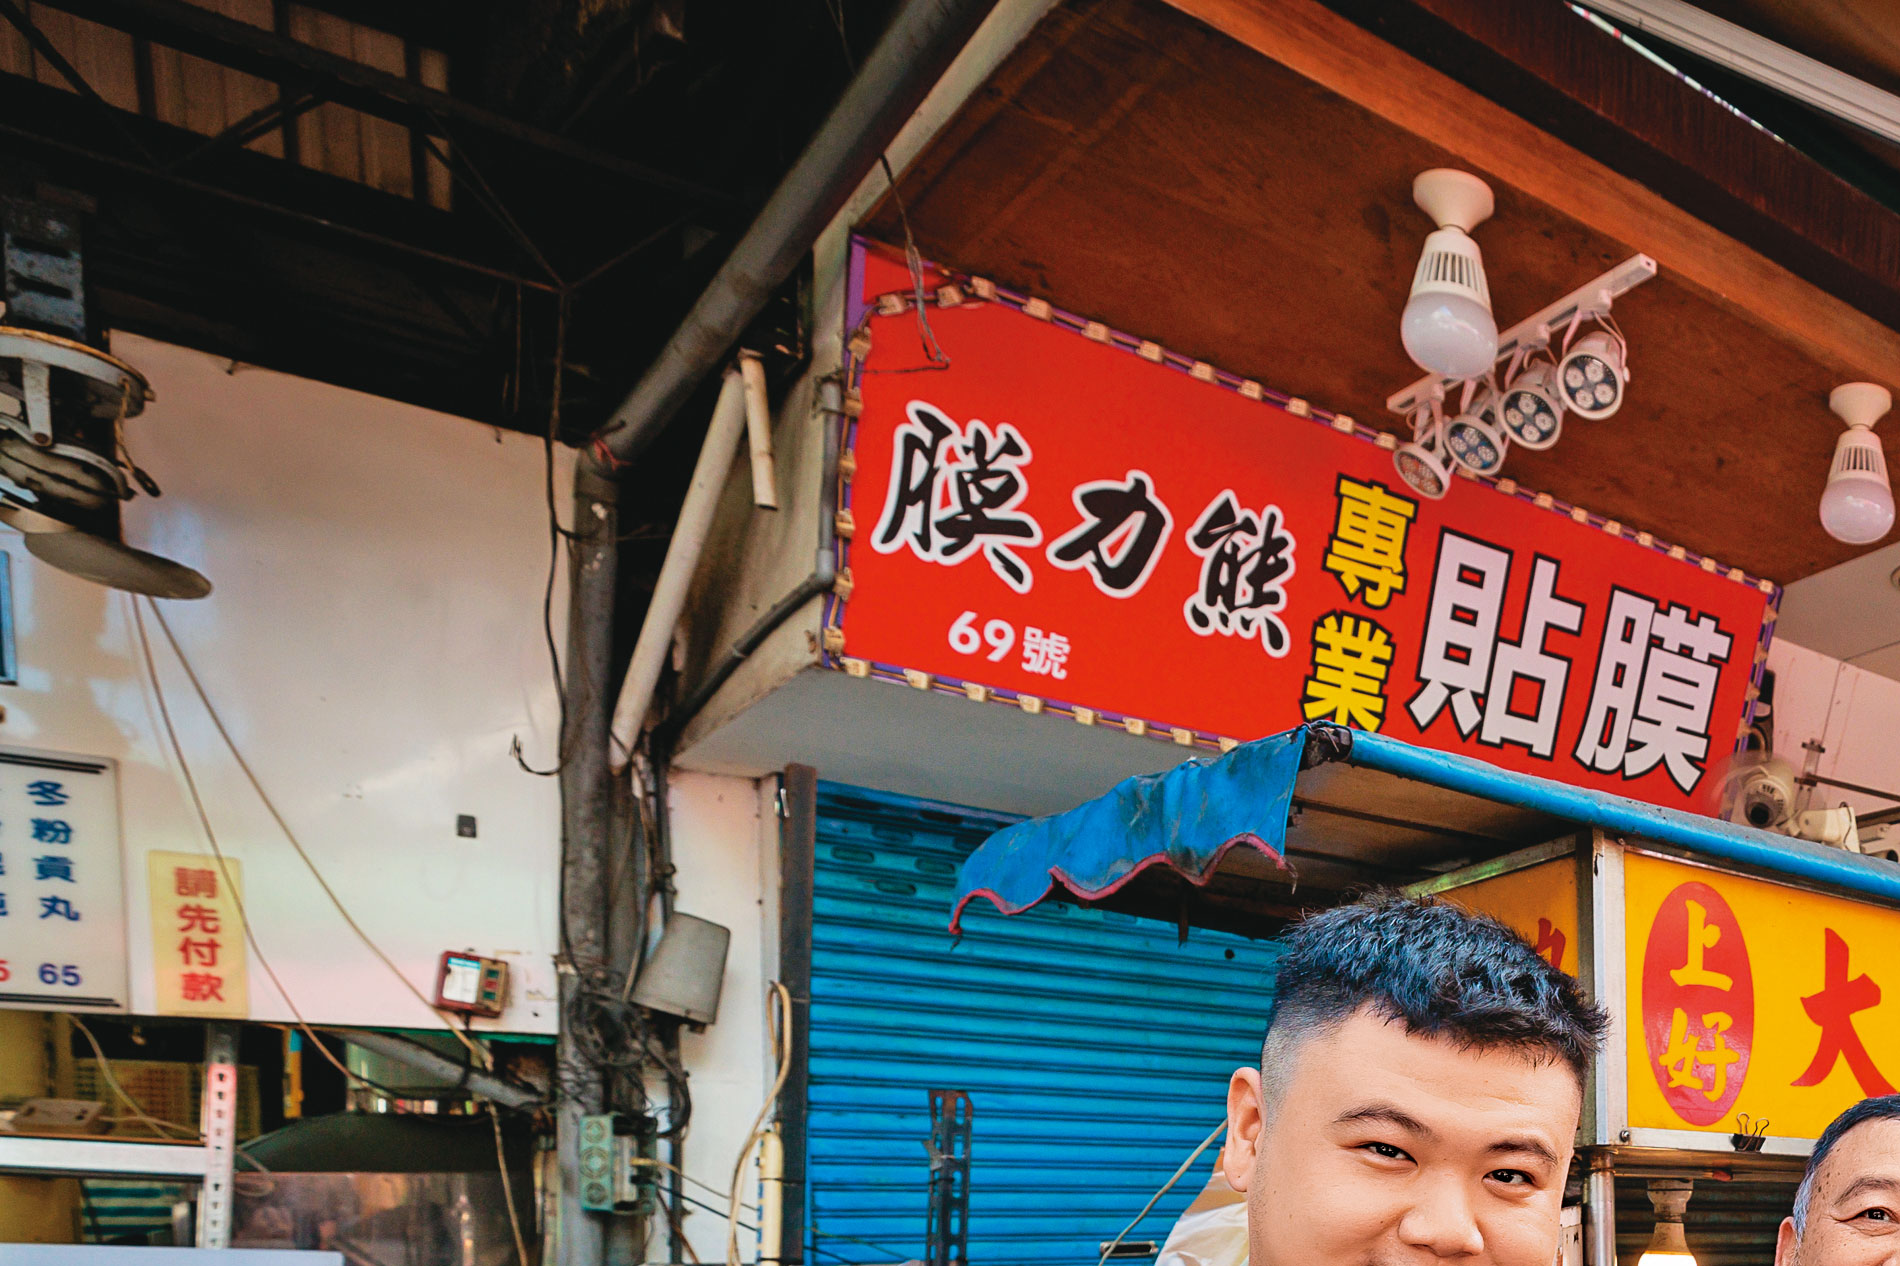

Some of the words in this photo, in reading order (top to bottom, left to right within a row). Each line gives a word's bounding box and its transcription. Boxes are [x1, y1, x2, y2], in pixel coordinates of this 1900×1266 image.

[872, 401, 1299, 657] 膜力熊
[1302, 473, 1420, 733] 專業
[1408, 526, 1733, 794] 貼膜
[27, 780, 80, 922] 冬粉貢丸
[173, 866, 225, 1003] 請先付款
[38, 963, 82, 987] 65
[1658, 899, 1741, 1103] 上好
